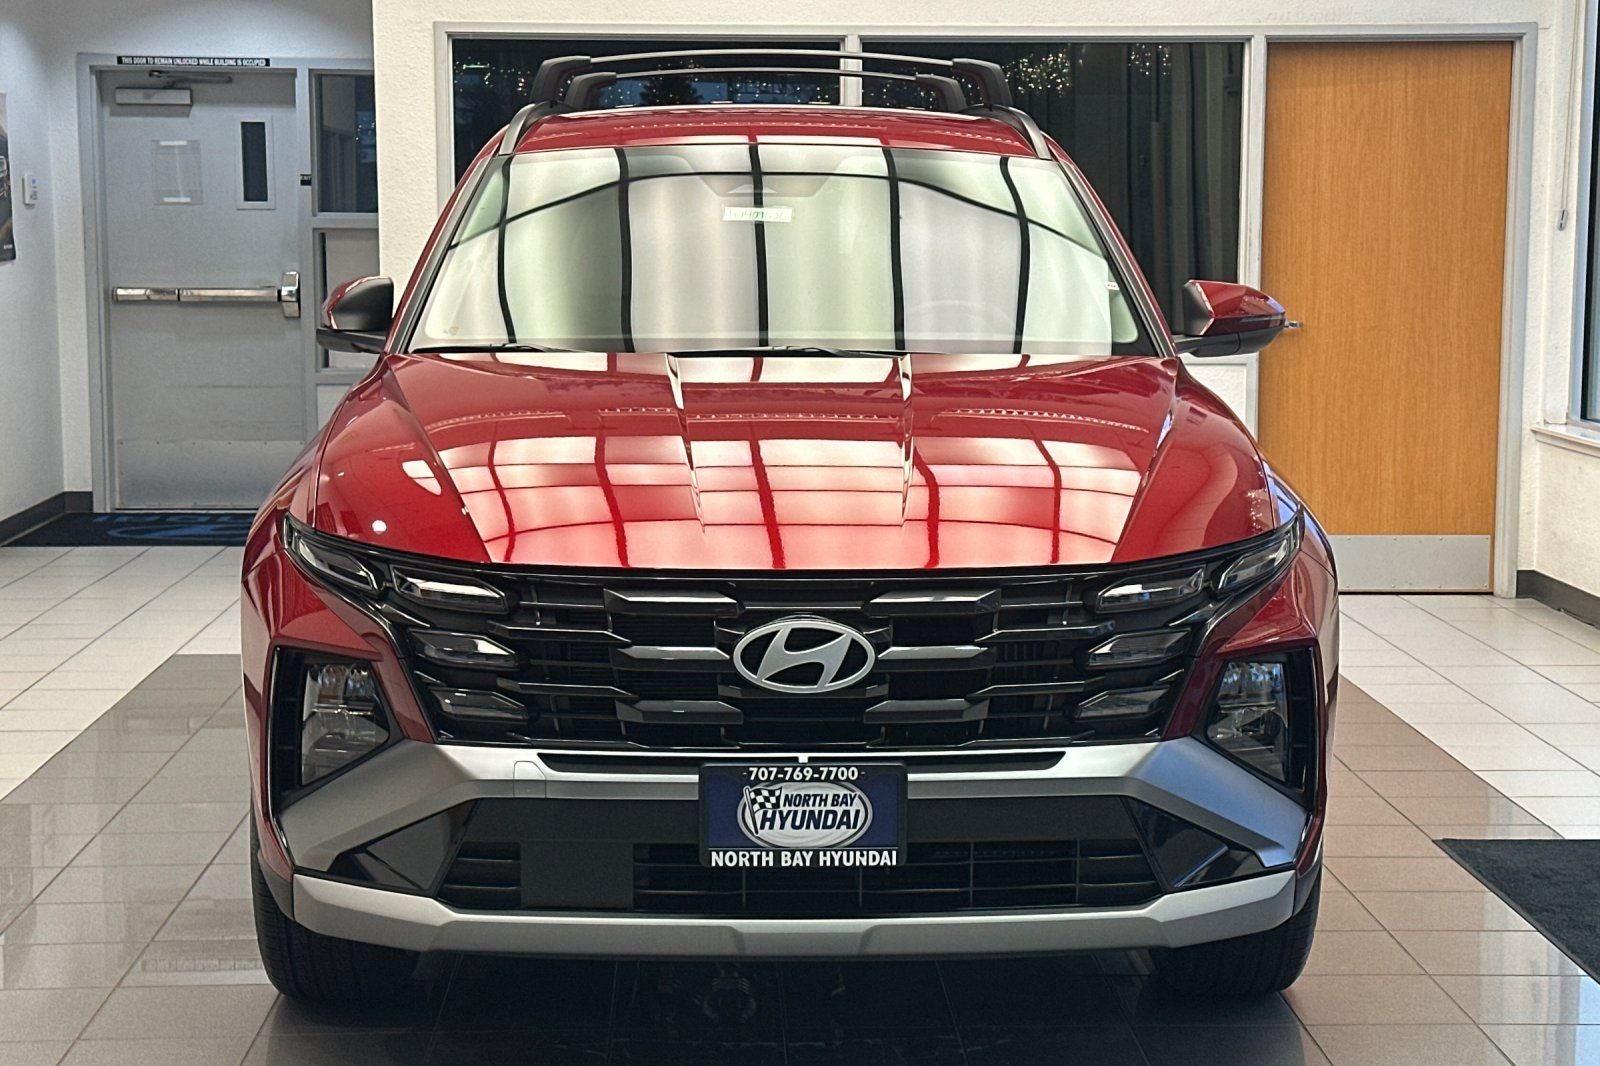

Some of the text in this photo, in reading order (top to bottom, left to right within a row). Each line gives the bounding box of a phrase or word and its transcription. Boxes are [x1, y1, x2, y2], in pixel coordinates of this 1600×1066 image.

[154, 57, 172, 65] REMAIN
[214, 58, 236, 66] BUILDING
[243, 58, 266, 66] OCCUPIED
[749, 767, 859, 781] 707-769-7700
[783, 793, 858, 808] NORTH BAY
[759, 809, 860, 830] HYUNDAI
[711, 850, 897, 867] NORTH BAY HYUNDAI
